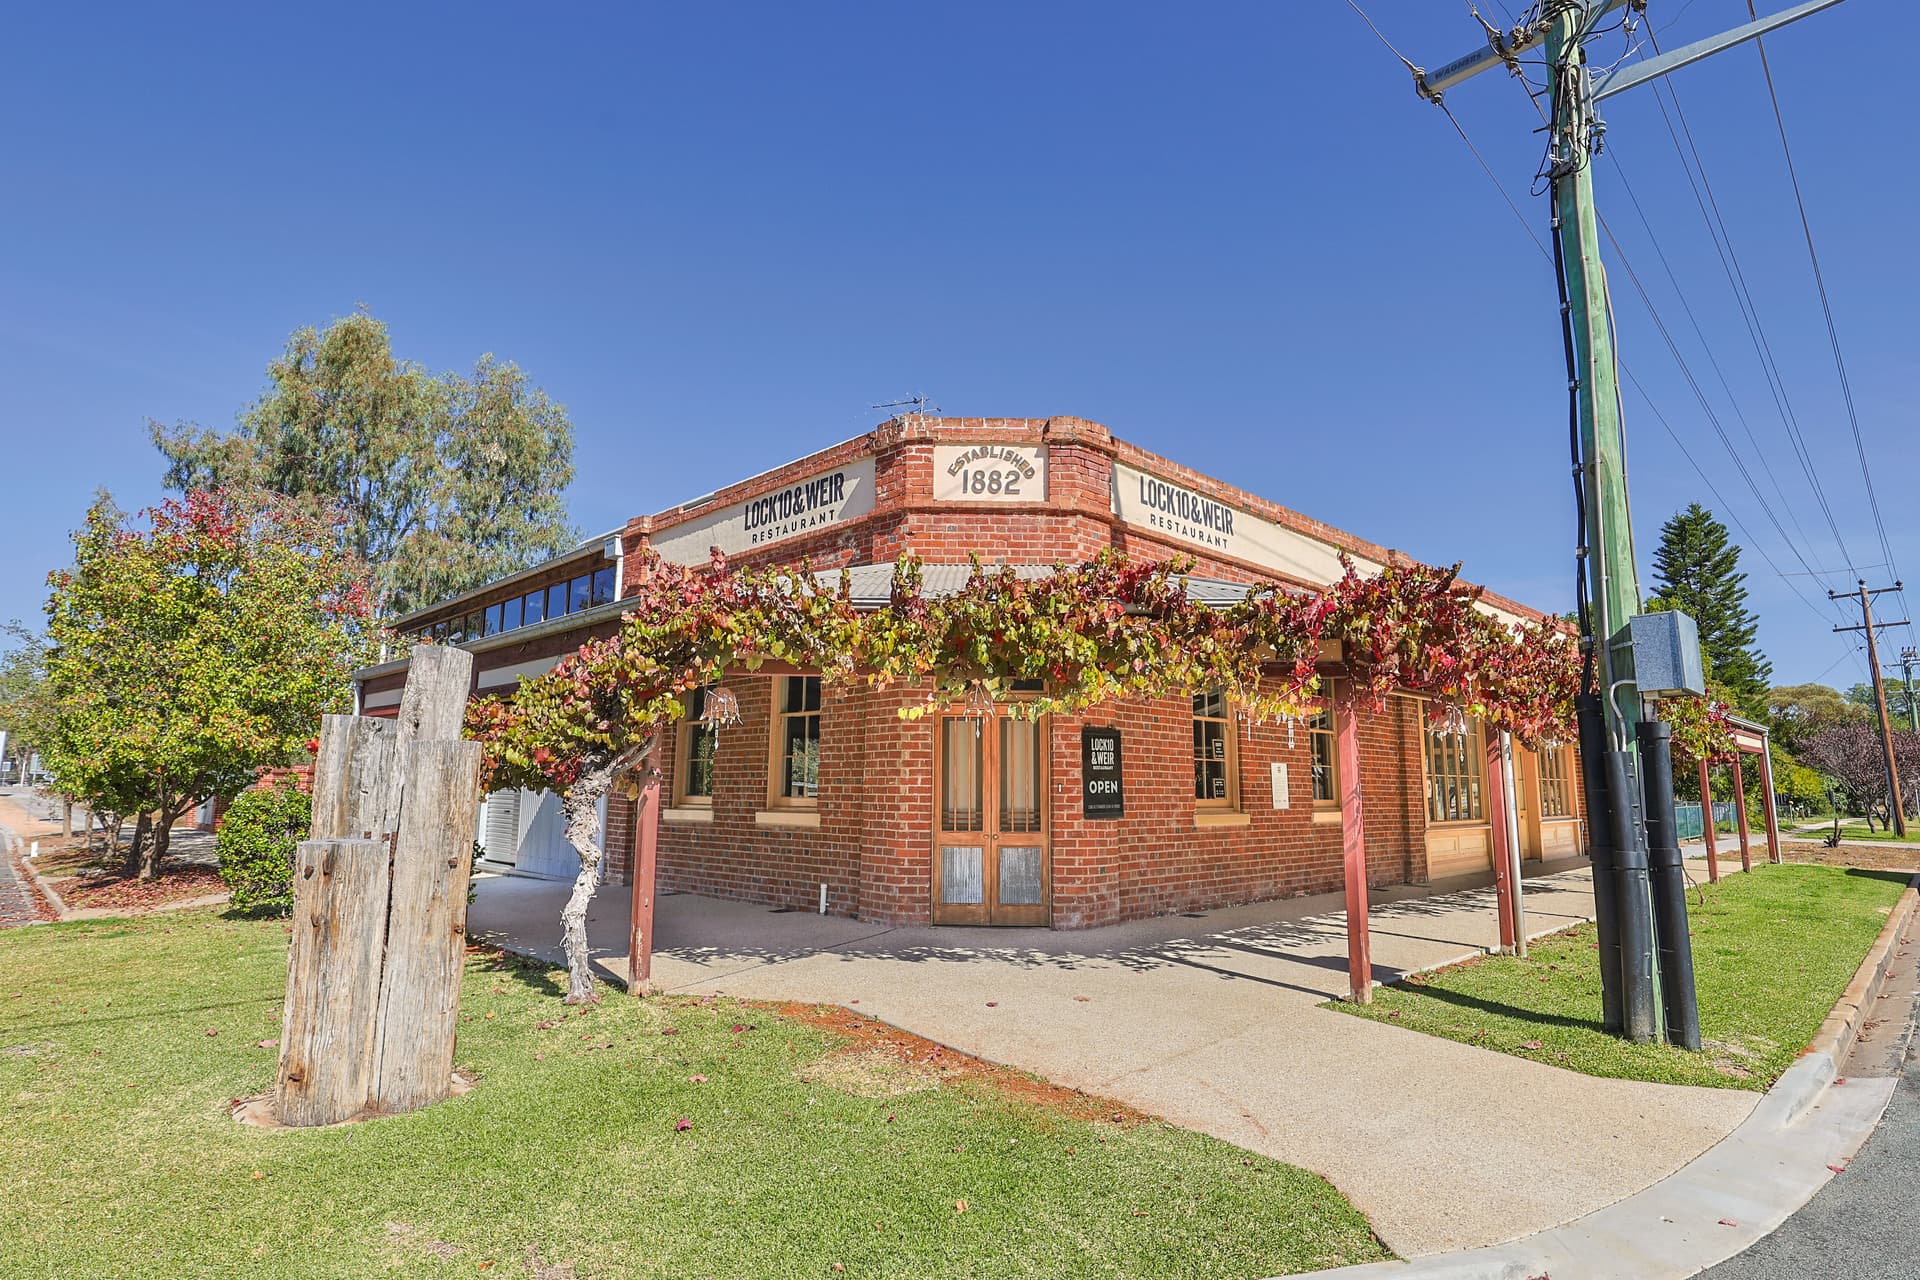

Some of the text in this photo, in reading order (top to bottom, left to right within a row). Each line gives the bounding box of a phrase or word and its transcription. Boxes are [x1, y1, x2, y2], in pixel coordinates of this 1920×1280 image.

[947, 446, 1036, 480] ESTABLISHED
[963, 469, 1021, 495] 1882
[751, 509, 836, 544] RESTAURANT
[1150, 513, 1228, 549] RESTAURANT
[1091, 738, 1114, 751] LOCK10
[1091, 752, 1115, 765] &WEIR
[1089, 781, 1118, 793] OPEN
